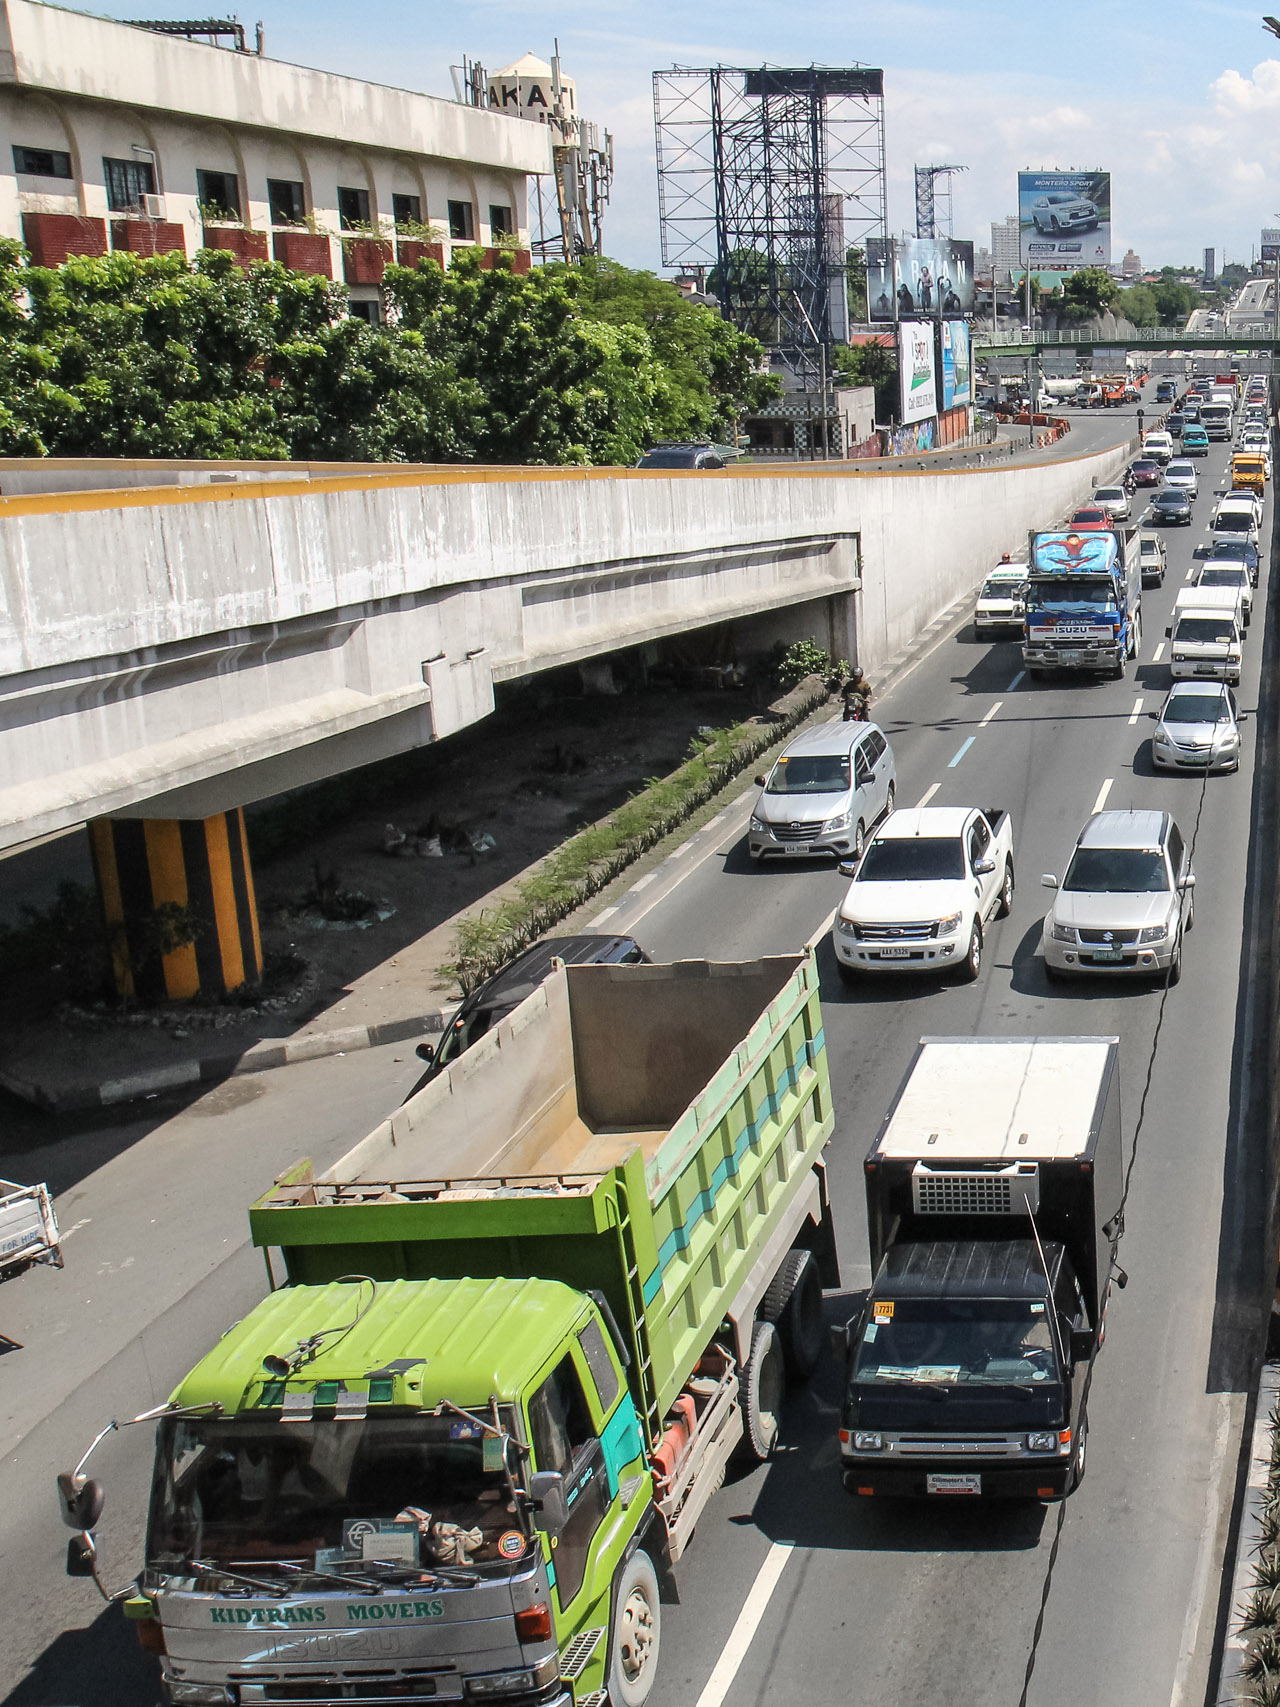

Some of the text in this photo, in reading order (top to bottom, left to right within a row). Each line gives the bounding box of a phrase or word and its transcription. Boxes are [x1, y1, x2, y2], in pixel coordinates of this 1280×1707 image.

[876, 258, 967, 285] TARZAN
[2, 1239, 18, 1253] FOR
[879, 1305, 893, 1313] 7731
[209, 1600, 444, 1624] KIDTRANS MOVERS
[265, 1632, 402, 1659] ISUZU
